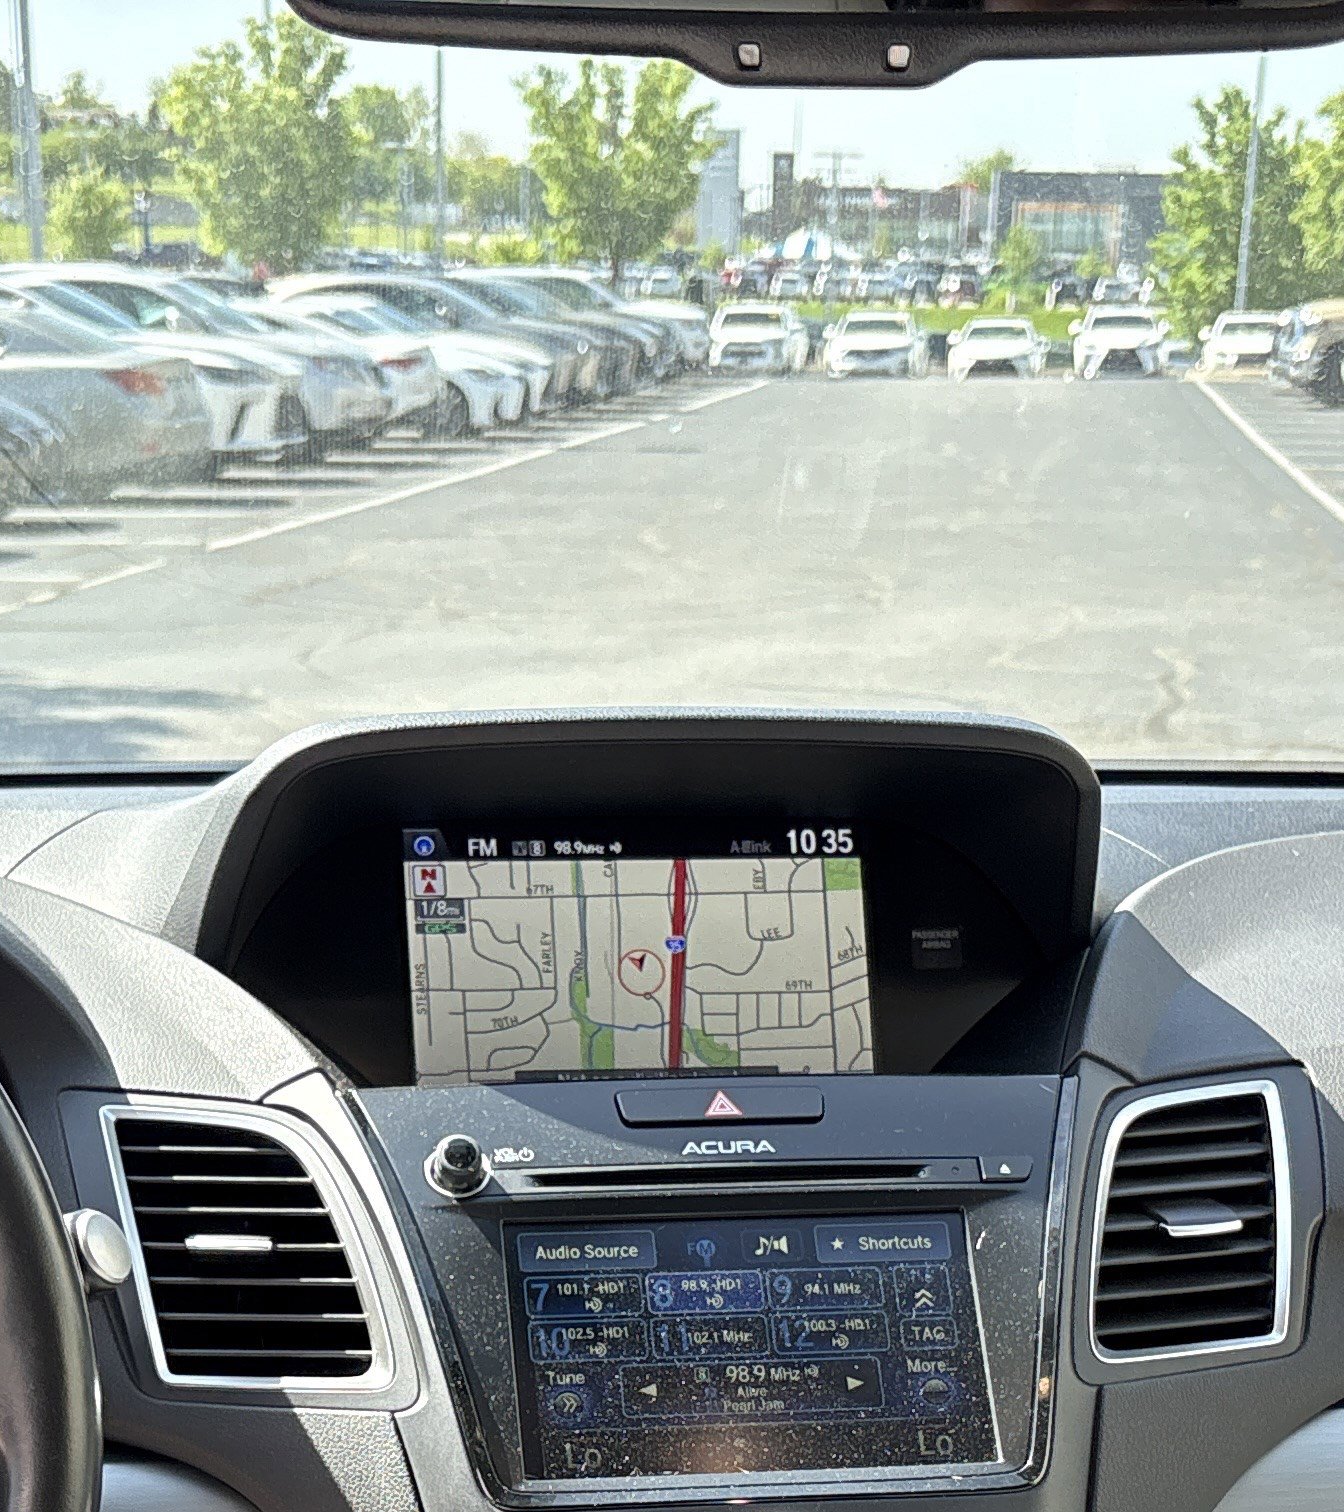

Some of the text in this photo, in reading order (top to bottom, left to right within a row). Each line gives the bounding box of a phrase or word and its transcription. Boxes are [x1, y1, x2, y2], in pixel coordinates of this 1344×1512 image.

[467, 838, 498, 857] FM
[421, 869, 437, 880] N
[761, 927, 782, 940] LEE
[541, 931, 552, 974] FARLEY
[415, 963, 427, 1015] STEARNS
[785, 980, 813, 990] 69TH
[681, 1140, 776, 1155] ACURA
[858, 1235, 932, 1251] Shortcuts
[535, 1243, 639, 1260] Audio Source
[654, 1279, 673, 1307] 8
[773, 1275, 861, 1303] 9 94.1 MHz
[531, 1283, 549, 1312] 7
[911, 1326, 946, 1341] TAG
[545, 1370, 586, 1385] Tune
[725, 1365, 765, 1383] 98.9
[770, 1367, 800, 1382] MHz
[759, 1399, 785, 1411] Jam
